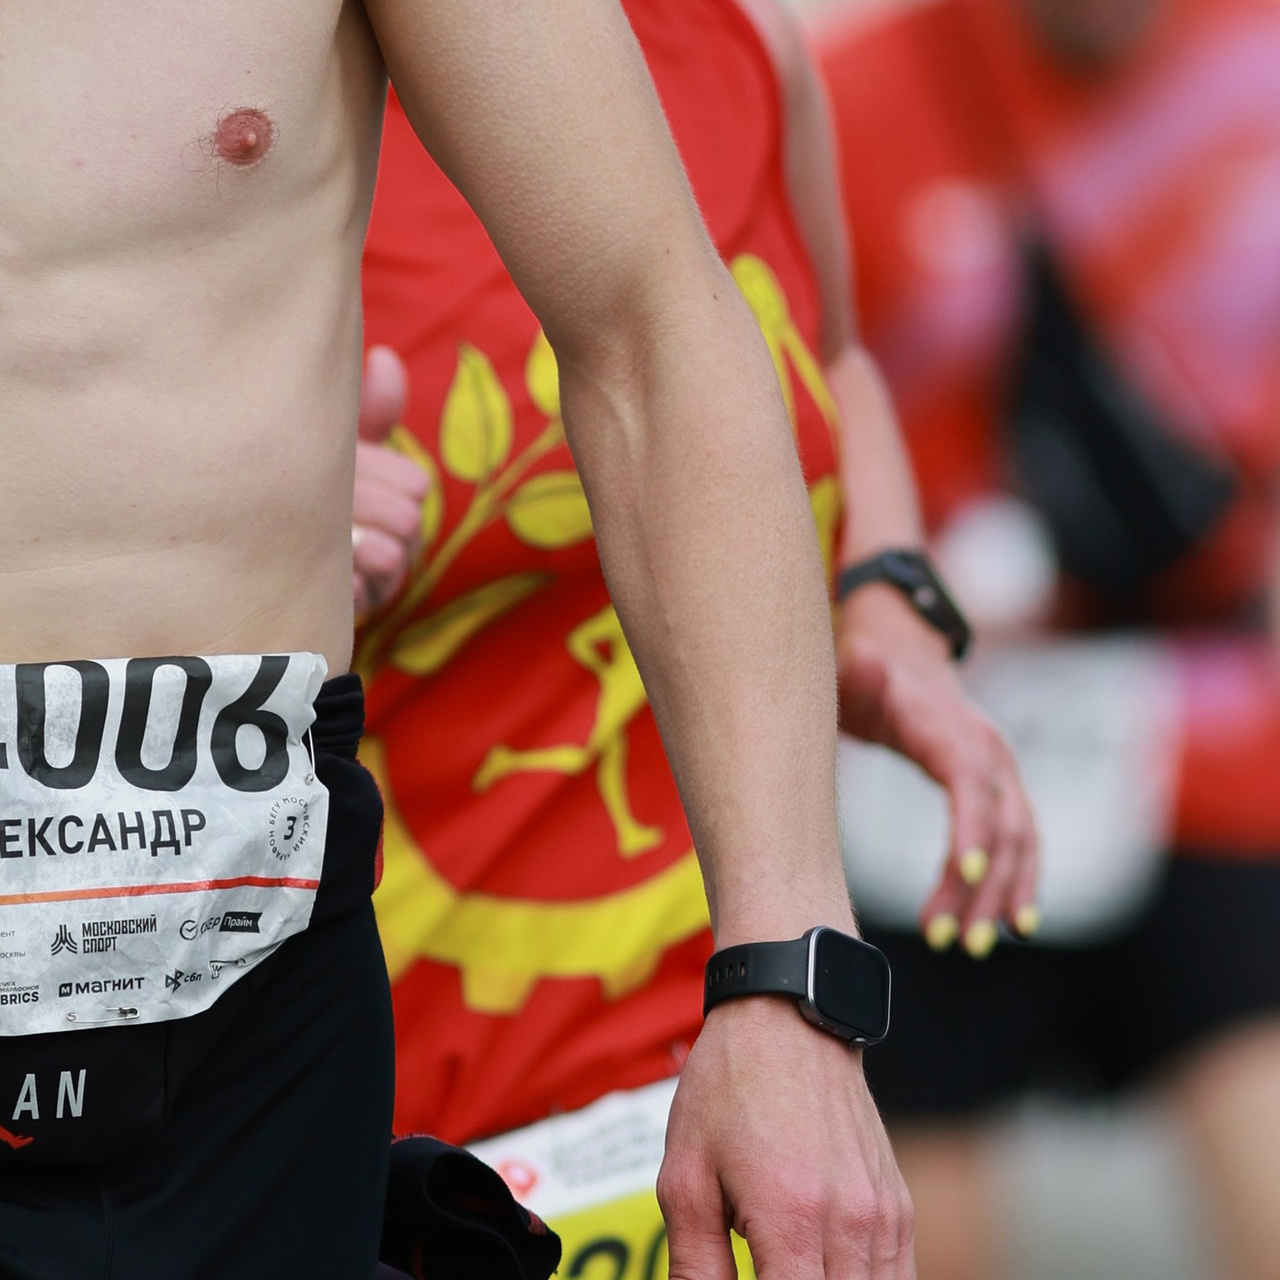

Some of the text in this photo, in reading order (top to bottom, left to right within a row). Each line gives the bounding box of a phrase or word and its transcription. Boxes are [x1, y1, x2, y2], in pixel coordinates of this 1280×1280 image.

[283, 816, 297, 840] 3
[82, 914, 157, 938] МОСКОВСКИЙ
[223, 917, 253, 928] Прайм
[83, 936, 117, 954] СПОРТ
[0, 985, 39, 993] МАРАФОНОВ
[0, 991, 39, 1005] BRICS
